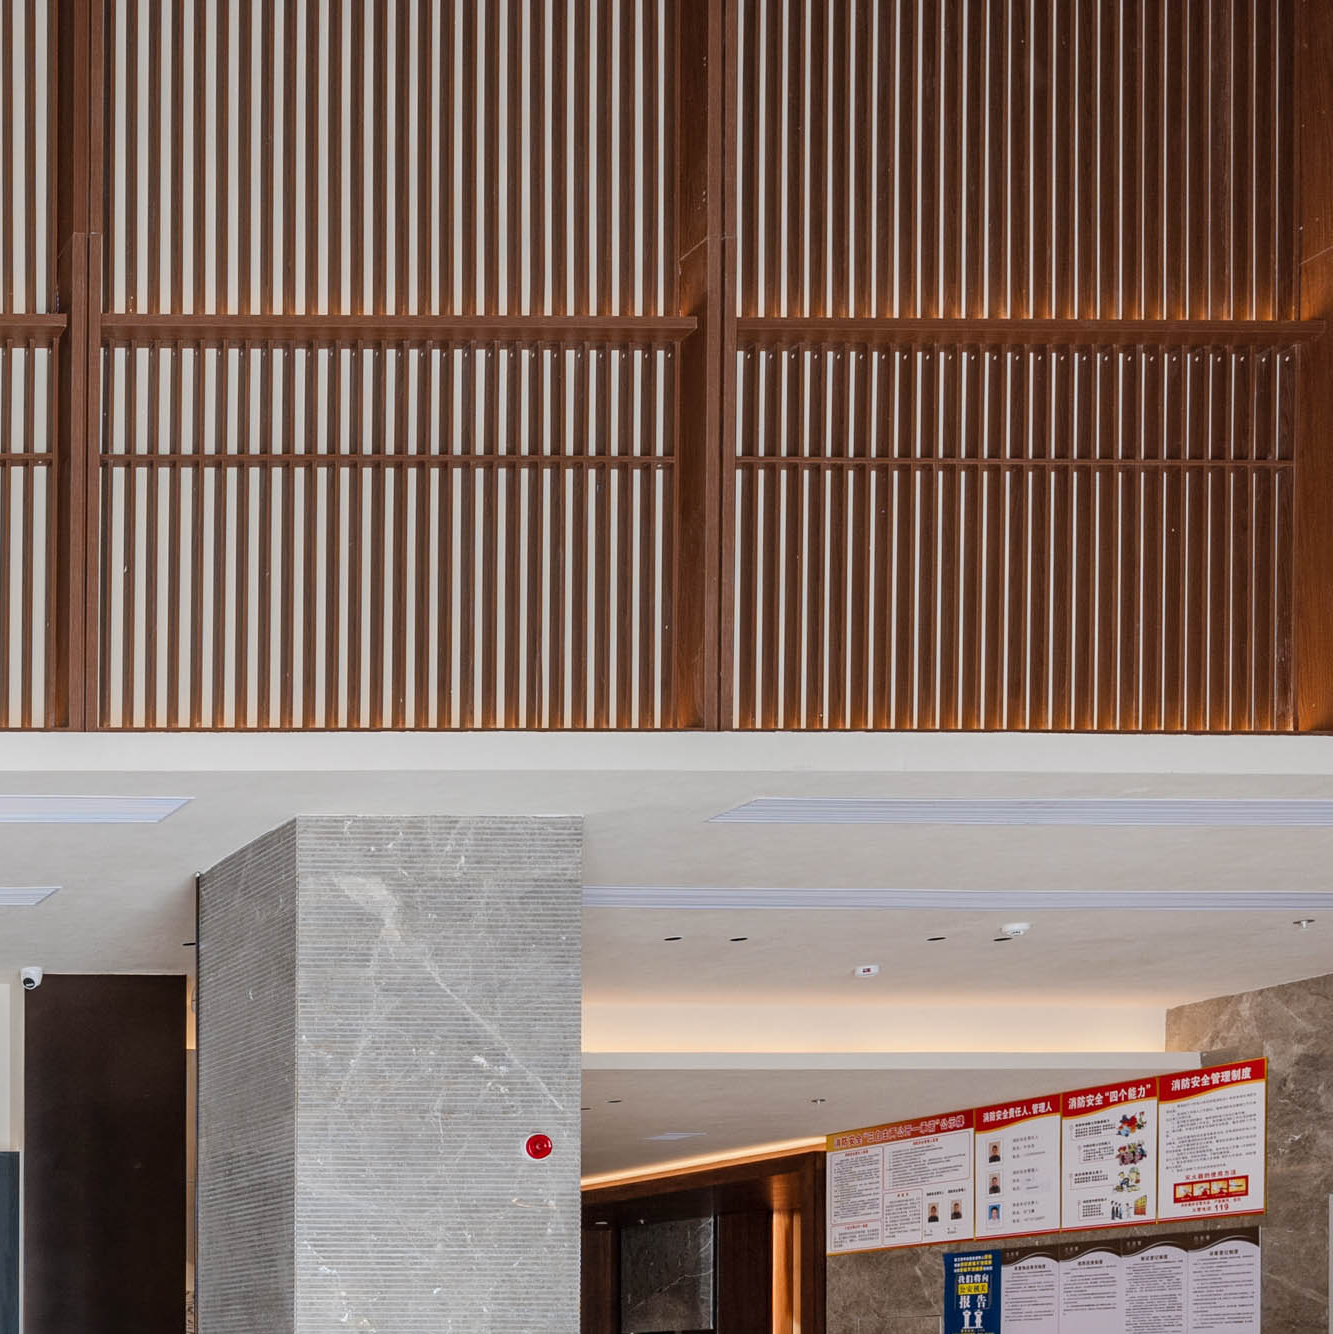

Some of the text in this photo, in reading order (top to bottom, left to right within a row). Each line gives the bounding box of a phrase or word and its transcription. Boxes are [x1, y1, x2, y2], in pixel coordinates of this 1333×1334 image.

[1171, 1067, 1252, 1091] 消防安全管理制度
[1214, 1202, 1229, 1212] 119
[959, 1294, 988, 1309] 报告
